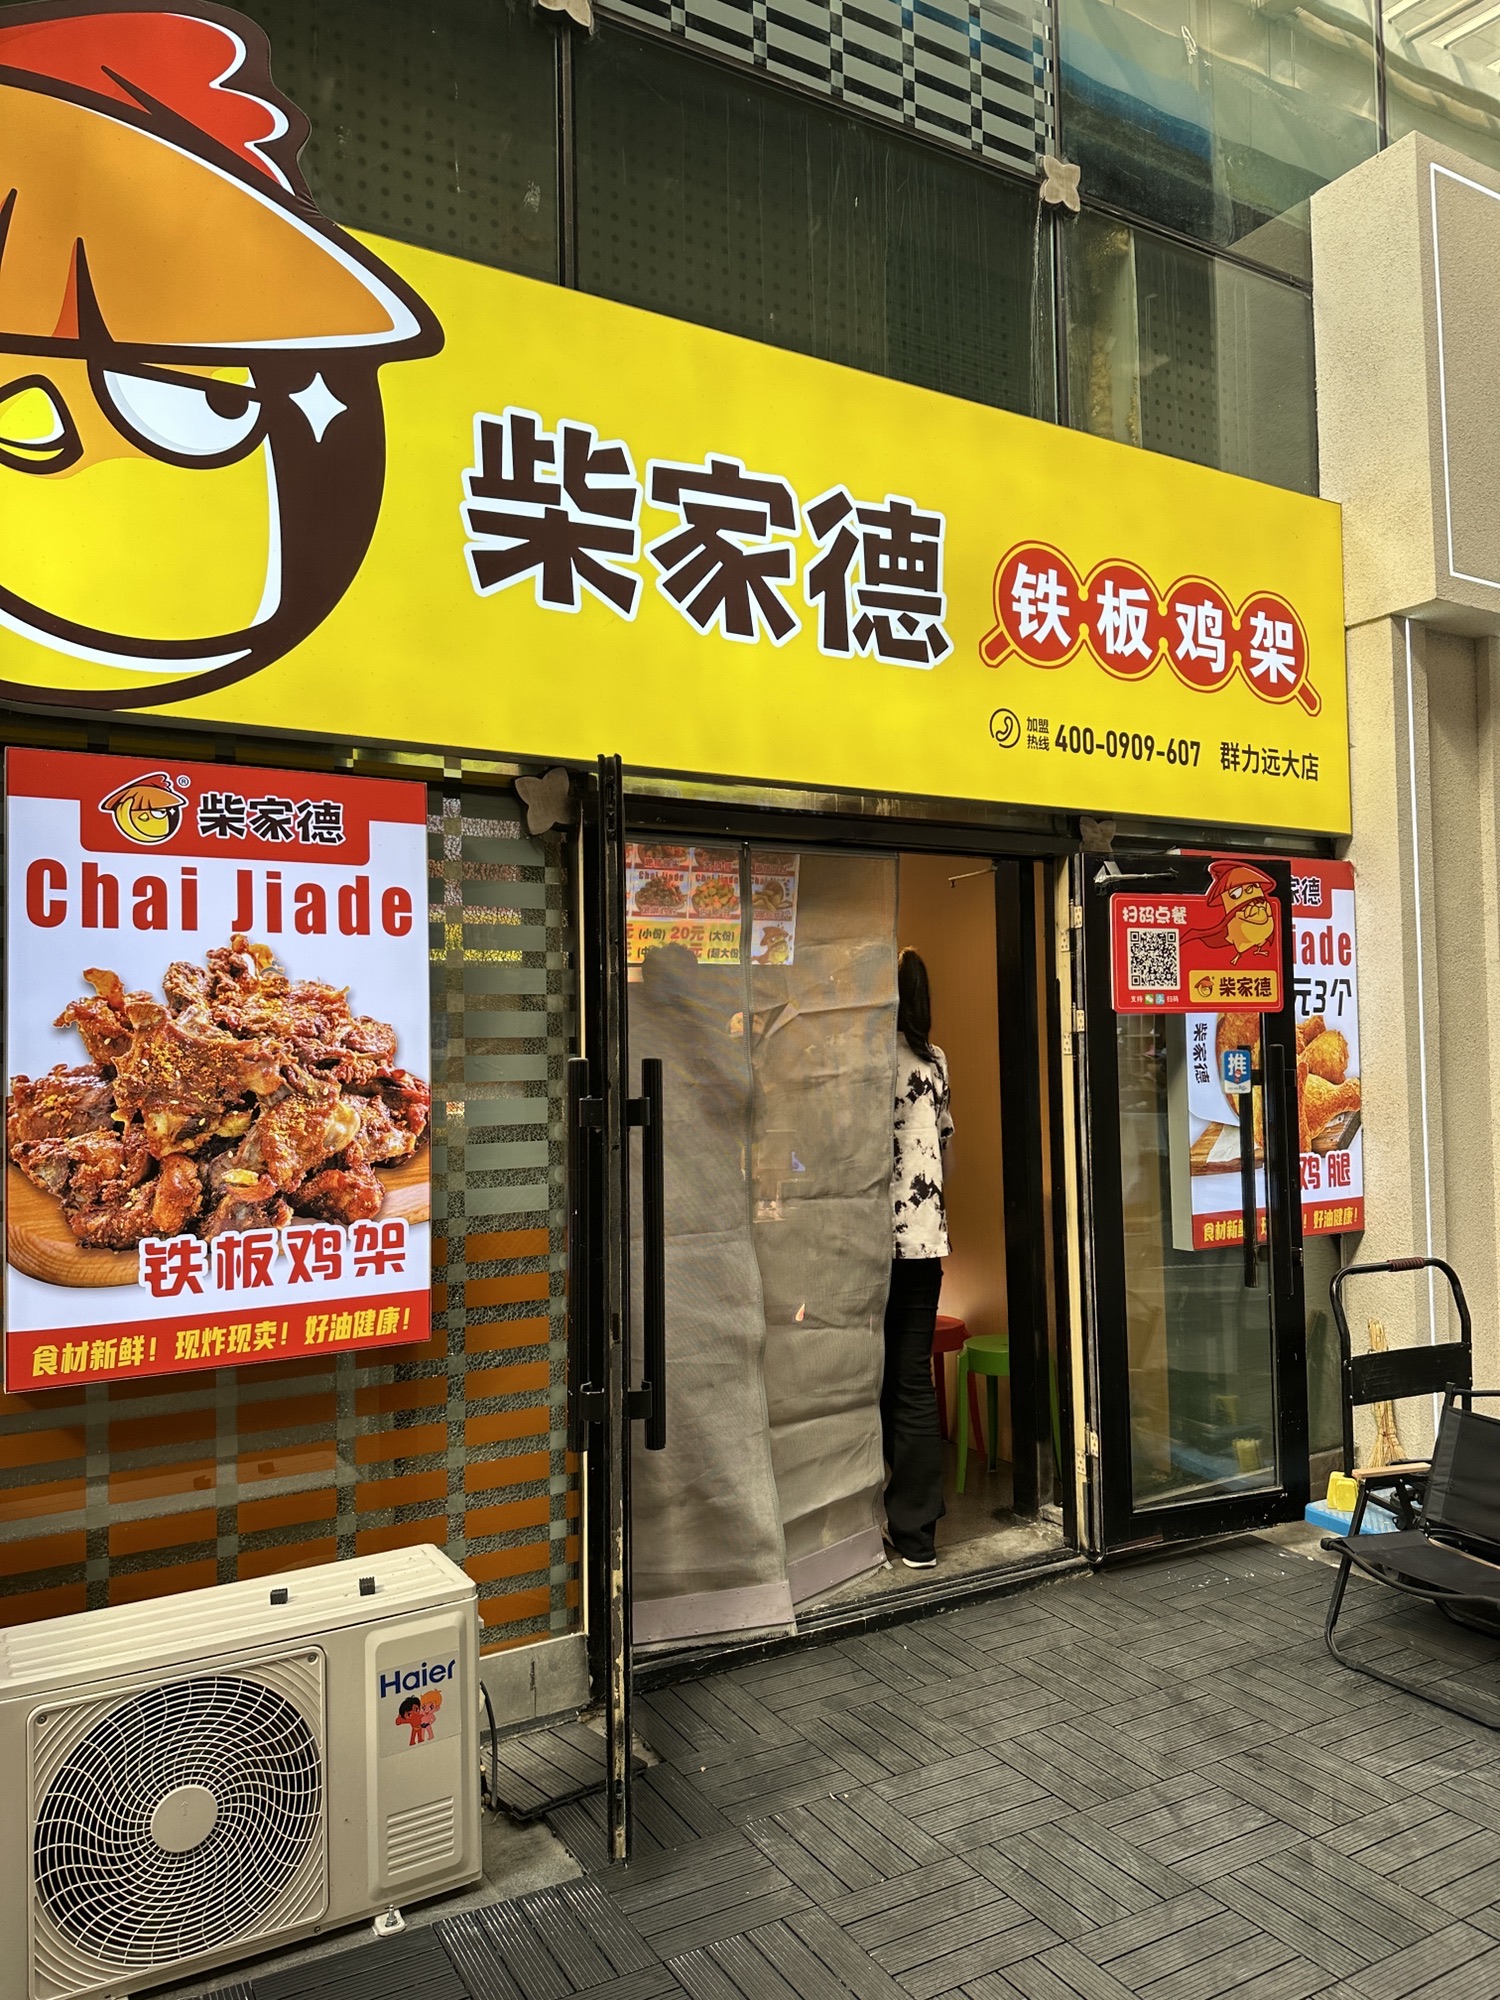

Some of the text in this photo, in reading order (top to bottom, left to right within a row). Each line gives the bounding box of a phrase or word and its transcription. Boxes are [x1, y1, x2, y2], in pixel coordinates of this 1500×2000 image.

[464, 410, 952, 667] 柴家德
[1010, 562, 1298, 685] 铁板鸡架
[1026, 716, 1050, 734] 加盟
[1026, 734, 1050, 752] 热线
[1054, 724, 1320, 781] 400-0909-607 群力远大店
[198, 791, 346, 845] 柴家德
[25, 857, 414, 938] Chai Jiade
[1122, 905, 1187, 925] 扫码点餐
[670, 925, 705, 941] 20元
[706, 948, 739, 960] (超大份
[1218, 976, 1273, 998] 柴家德
[1193, 1022, 1210, 1084] 柴家德
[1227, 1053, 1248, 1076] 推
[1313, 1206, 1358, 1229] 好油健康！
[144, 1220, 407, 1298] 铁板鸡架
[31, 1306, 411, 1377] 食材新鲜！ 现炸现卖！ 好油健康！
[380, 1659, 456, 1698] Haier
